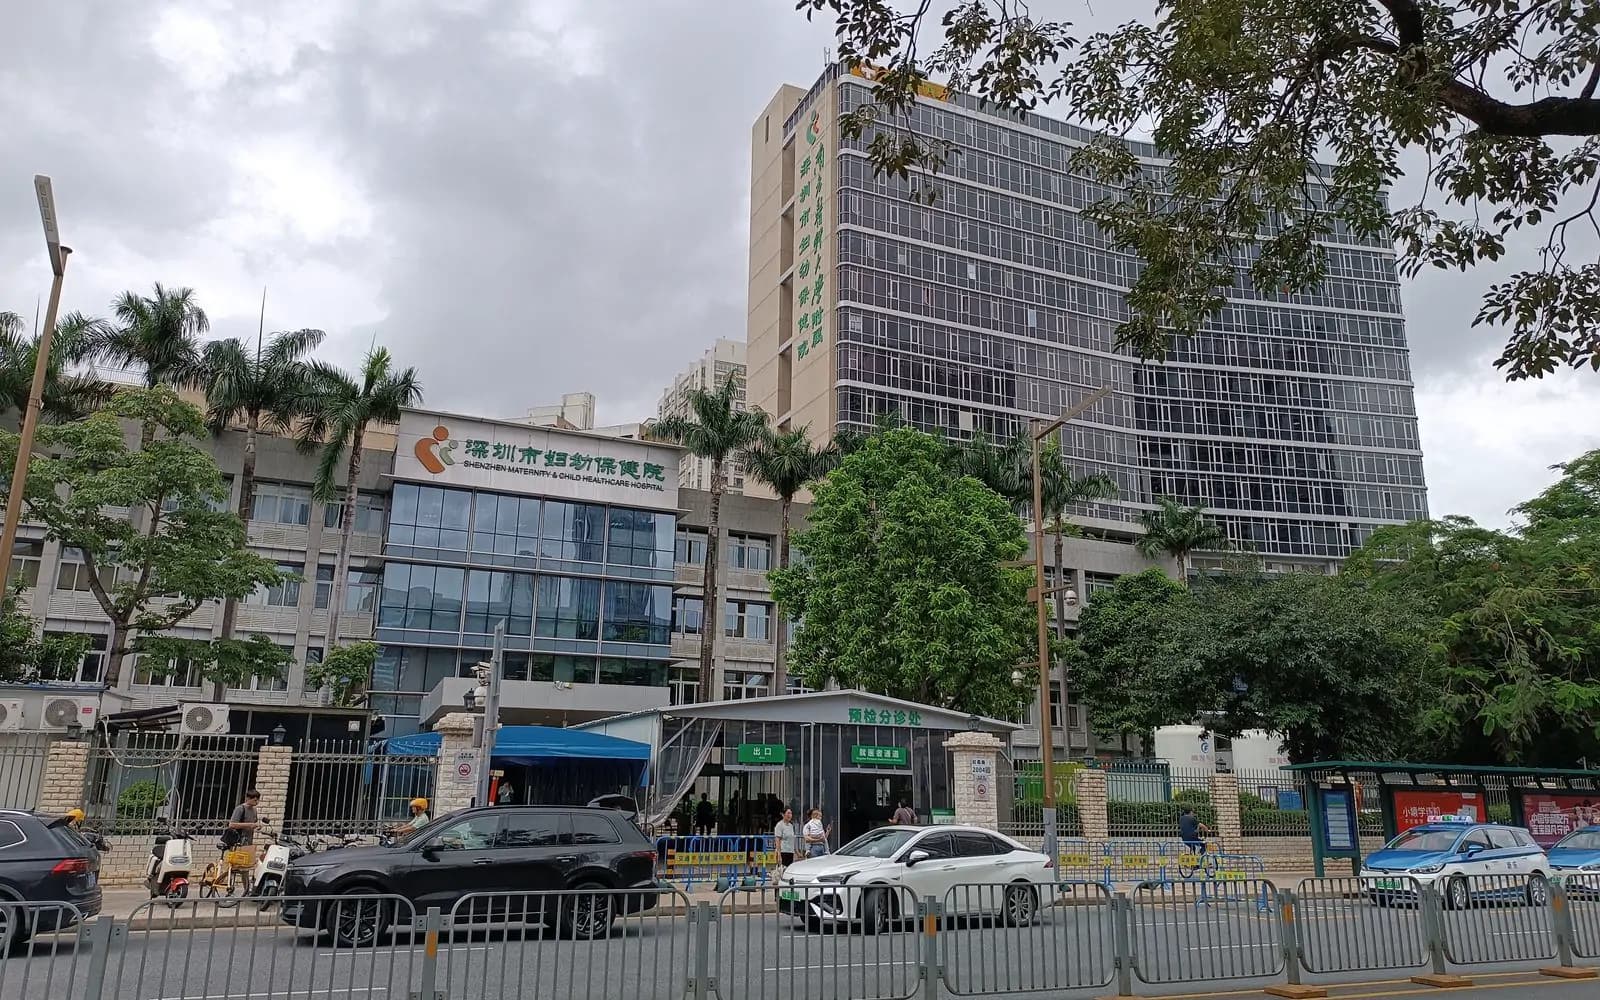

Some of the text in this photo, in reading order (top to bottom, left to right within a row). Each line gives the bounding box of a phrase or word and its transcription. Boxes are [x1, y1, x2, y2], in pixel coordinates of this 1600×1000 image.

[464, 439, 666, 482] 深圳市妇幼保健院
[463, 460, 507, 472] SHENZHEN
[507, 465, 551, 477] MATERNITY
[558, 472, 581, 481] CHILD
[582, 475, 630, 488] HEALTHCARE
[630, 481, 665, 492] HOSPITAL
[848, 707, 922, 726] 预检分诊处
[753, 746, 772, 756] 出口
